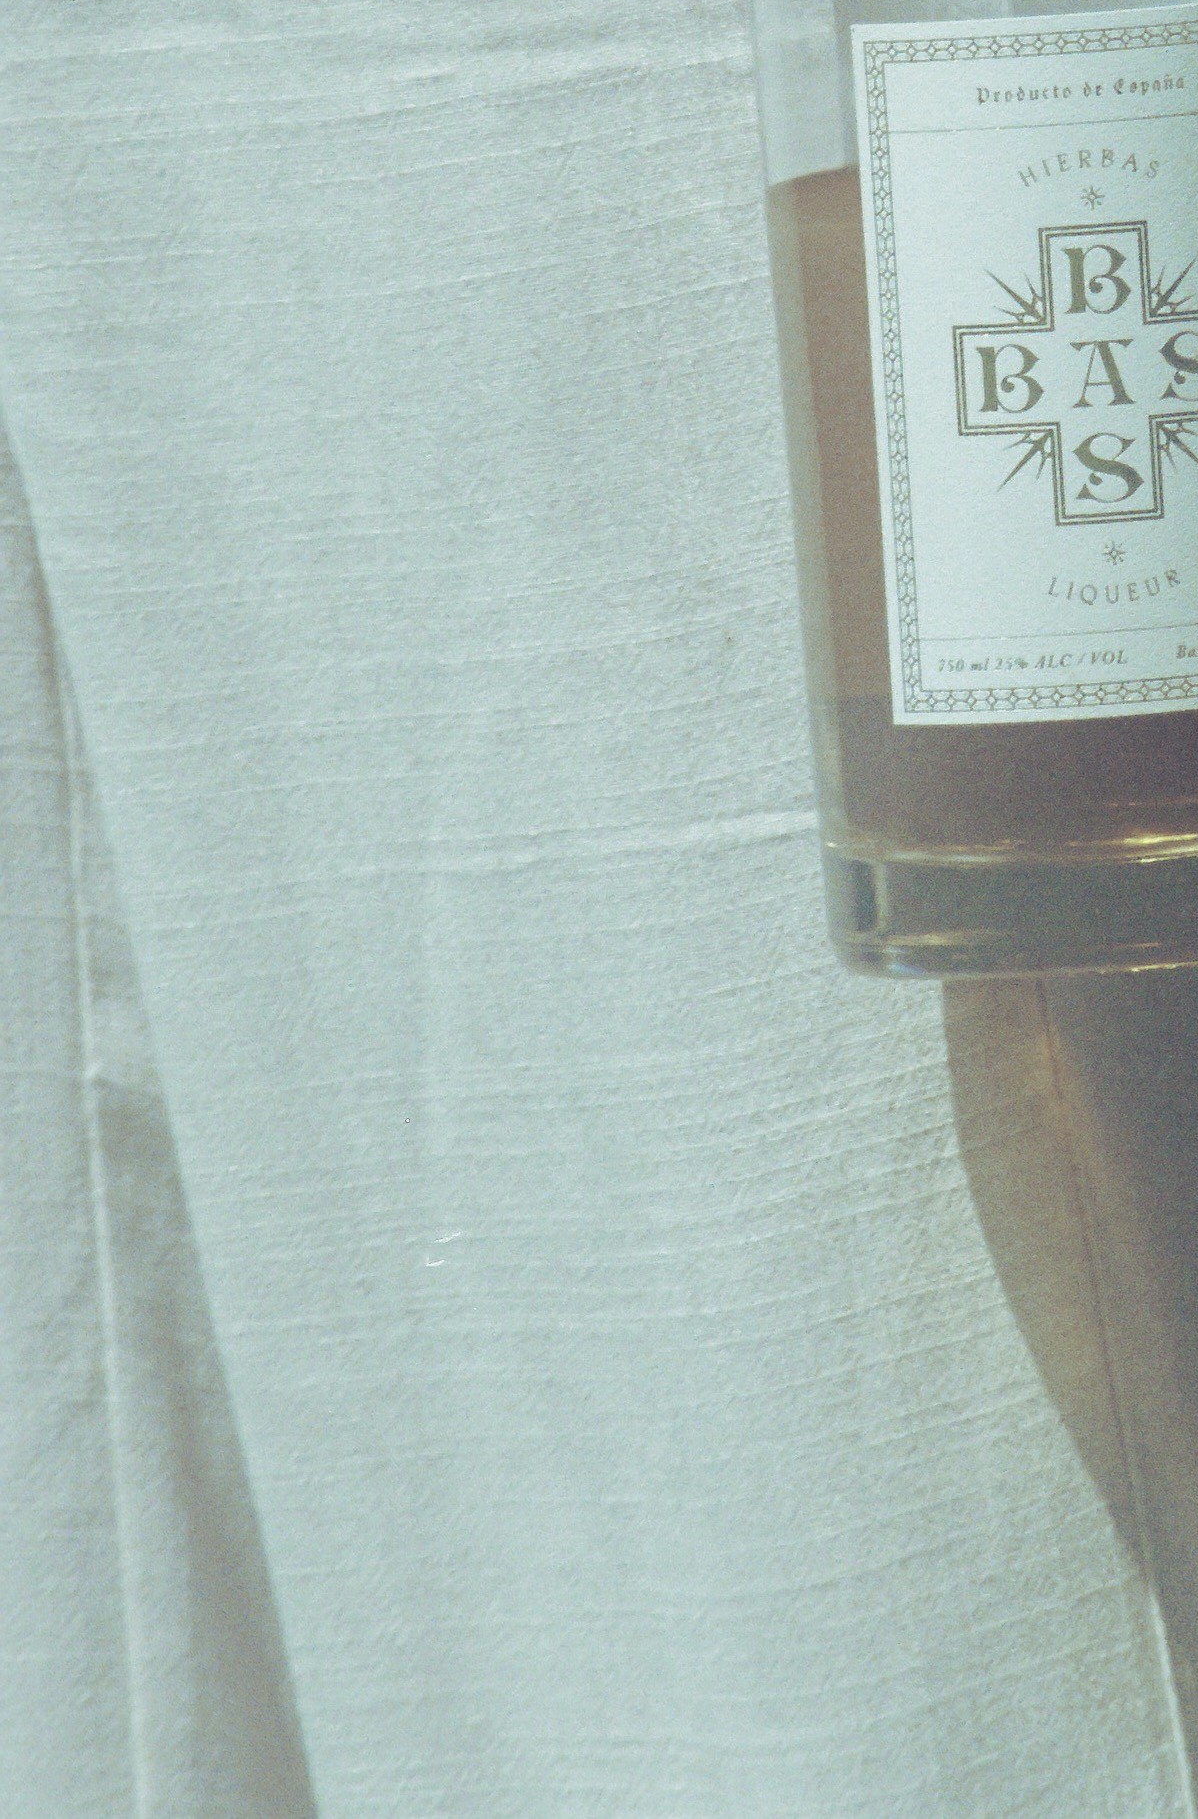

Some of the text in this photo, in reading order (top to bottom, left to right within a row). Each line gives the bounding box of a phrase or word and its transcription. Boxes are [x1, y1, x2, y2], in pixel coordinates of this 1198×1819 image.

[976, 74, 1186, 105] Producto de España
[1018, 148, 1160, 187] HIERBAS
[1061, 244, 1132, 315] B
[1072, 432, 1145, 503] S
[1047, 568, 1182, 606] LIQUEUR
[938, 658, 965, 672] 750
[970, 656, 990, 671] ml
